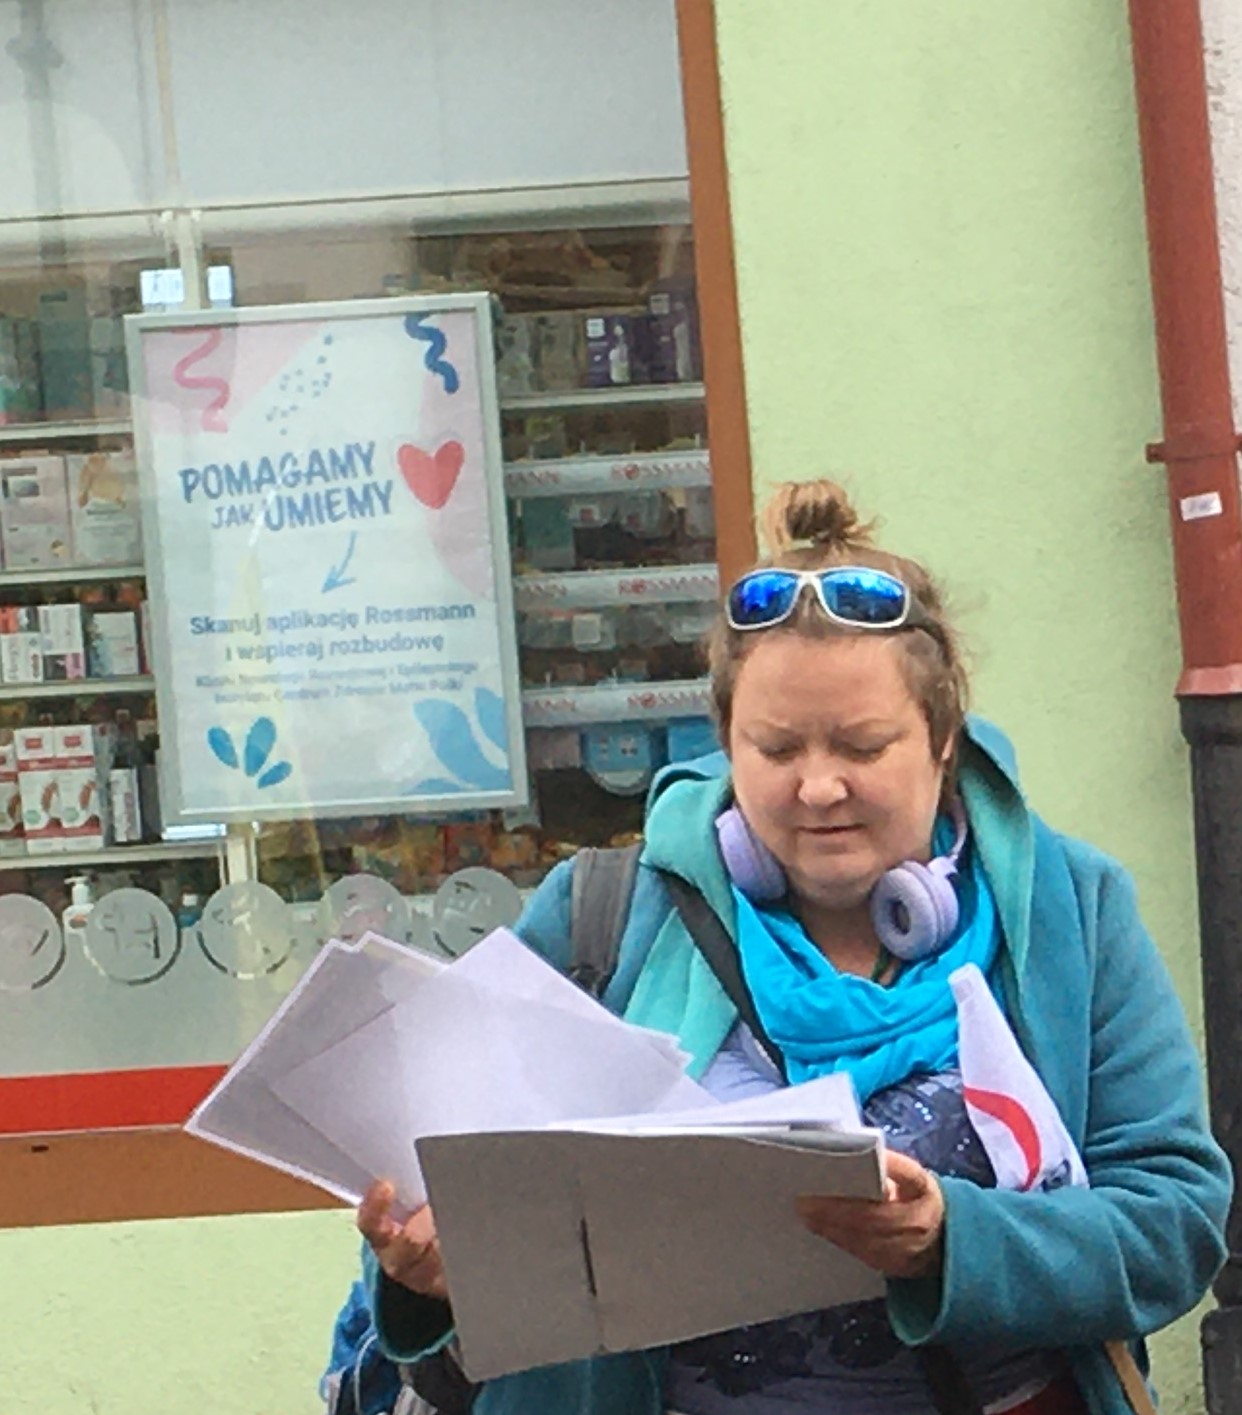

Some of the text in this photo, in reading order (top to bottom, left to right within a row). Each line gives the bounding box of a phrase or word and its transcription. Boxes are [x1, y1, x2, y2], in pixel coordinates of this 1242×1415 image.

[178, 440, 376, 504] POMAGAMY
[211, 479, 394, 532] JAK UMIEMY
[189, 602, 476, 637] Skanuj aplikację Rossmann
[237, 639, 325, 664] wspieraj
[329, 633, 444, 658] rozbudowę
